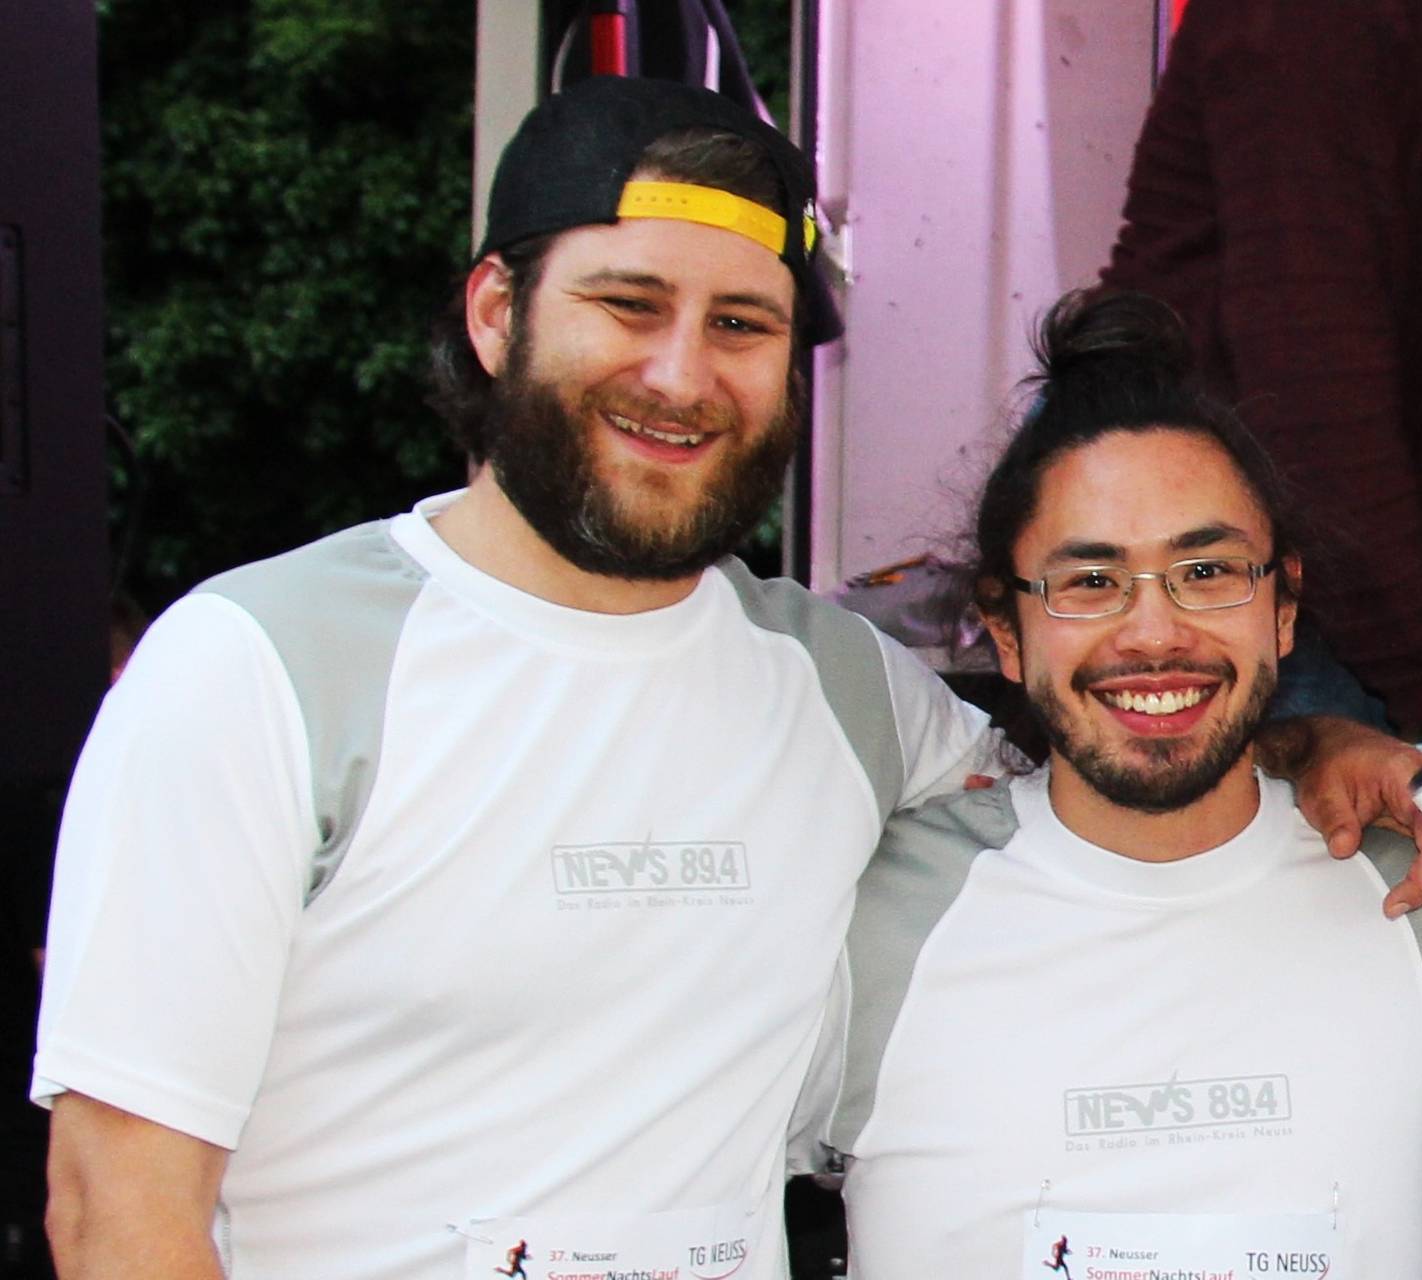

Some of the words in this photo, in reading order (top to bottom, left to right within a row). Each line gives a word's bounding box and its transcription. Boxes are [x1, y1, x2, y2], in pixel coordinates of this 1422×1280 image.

[680, 847, 739, 885] 89.4
[1207, 1081, 1278, 1119] 89.4
[1065, 1140, 1090, 1153] Das
[1100, 1137, 1137, 1150] Radio
[1253, 1125, 1293, 1138] Neuss
[549, 1250, 568, 1262] 37.
[572, 1251, 618, 1262] Neusser
[689, 1247, 706, 1266] TG
[711, 1239, 747, 1263] NEUSS
[1087, 1247, 1106, 1259] 37.
[1109, 1248, 1159, 1261] Neusser
[1245, 1252, 1269, 1272] TG
[1276, 1252, 1329, 1274] NEUSS
[1086, 1266, 1235, 1280] SommerNachtsLauf
